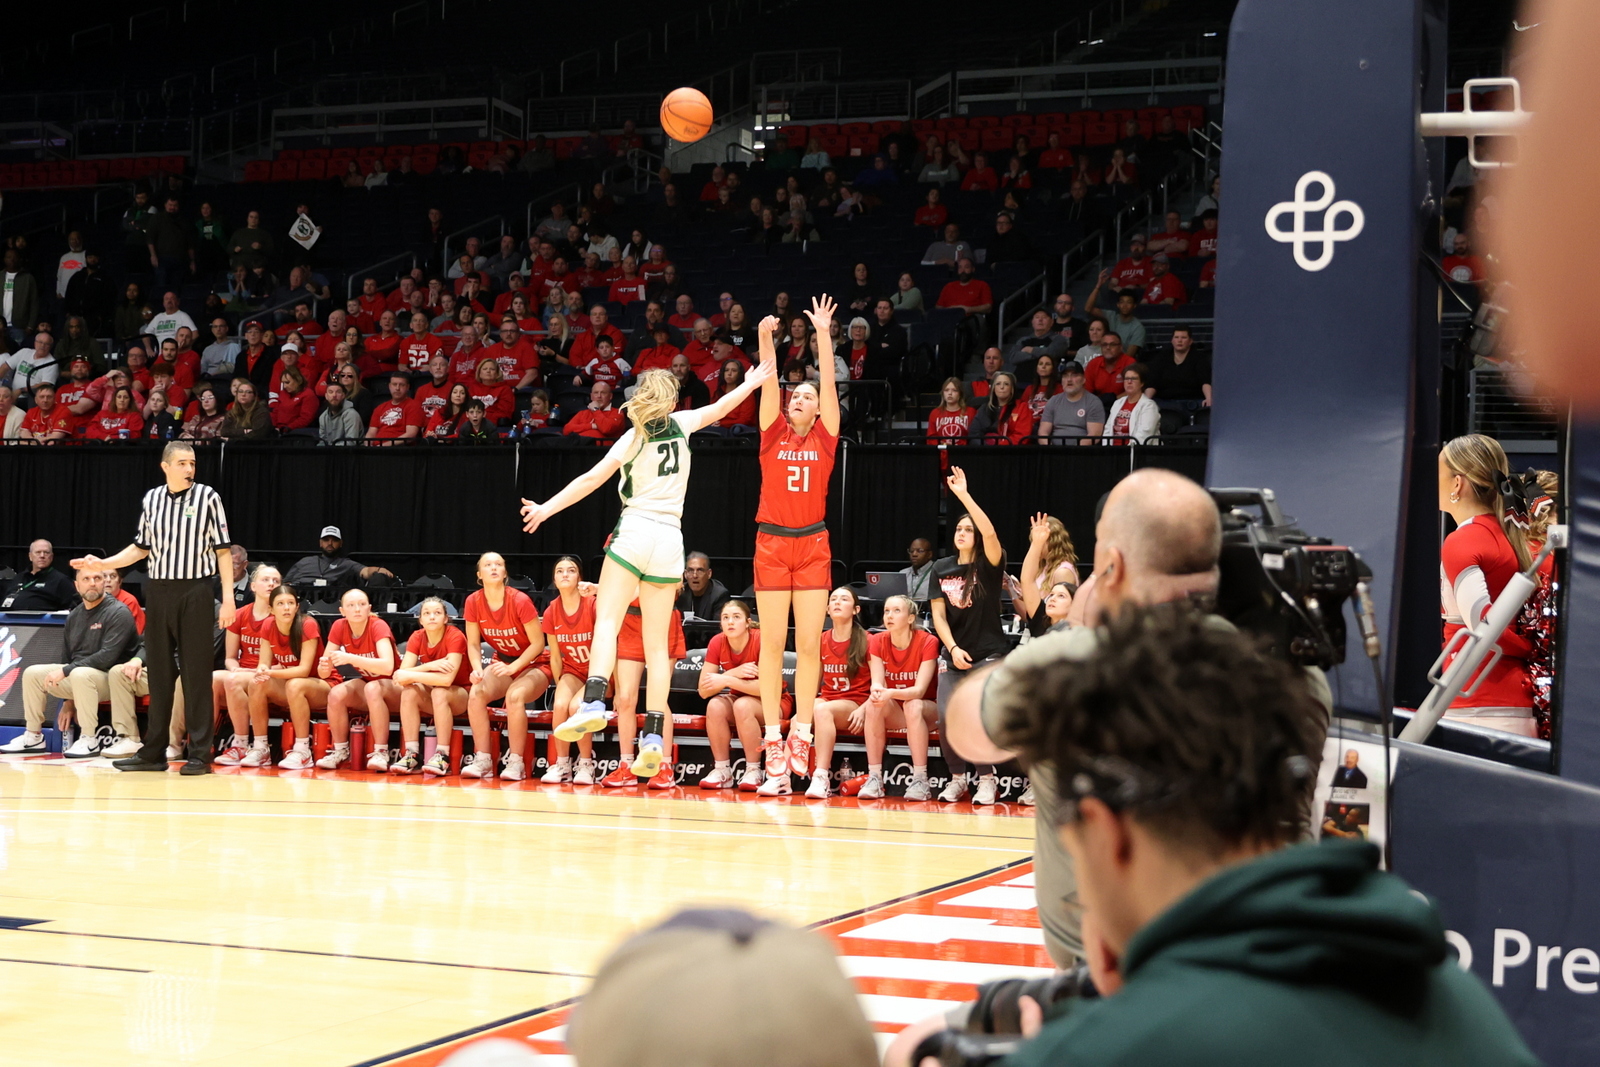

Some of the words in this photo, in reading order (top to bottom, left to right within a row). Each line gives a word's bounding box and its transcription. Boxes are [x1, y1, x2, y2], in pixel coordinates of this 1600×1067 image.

[936, 416, 954, 432] LADY
[955, 415, 969, 430] RED
[656, 440, 680, 478] 21
[786, 465, 811, 493] 21
[483, 627, 519, 637] BELLEVUE
[556, 632, 593, 643] BELLEVUE
[493, 638, 521, 653] 24
[566, 645, 591, 663] 20
[832, 677, 851, 692] 13
[675, 763, 705, 783] ger
[883, 763, 948, 789] Kroer
[1492, 928, 1600, 995] Pre
